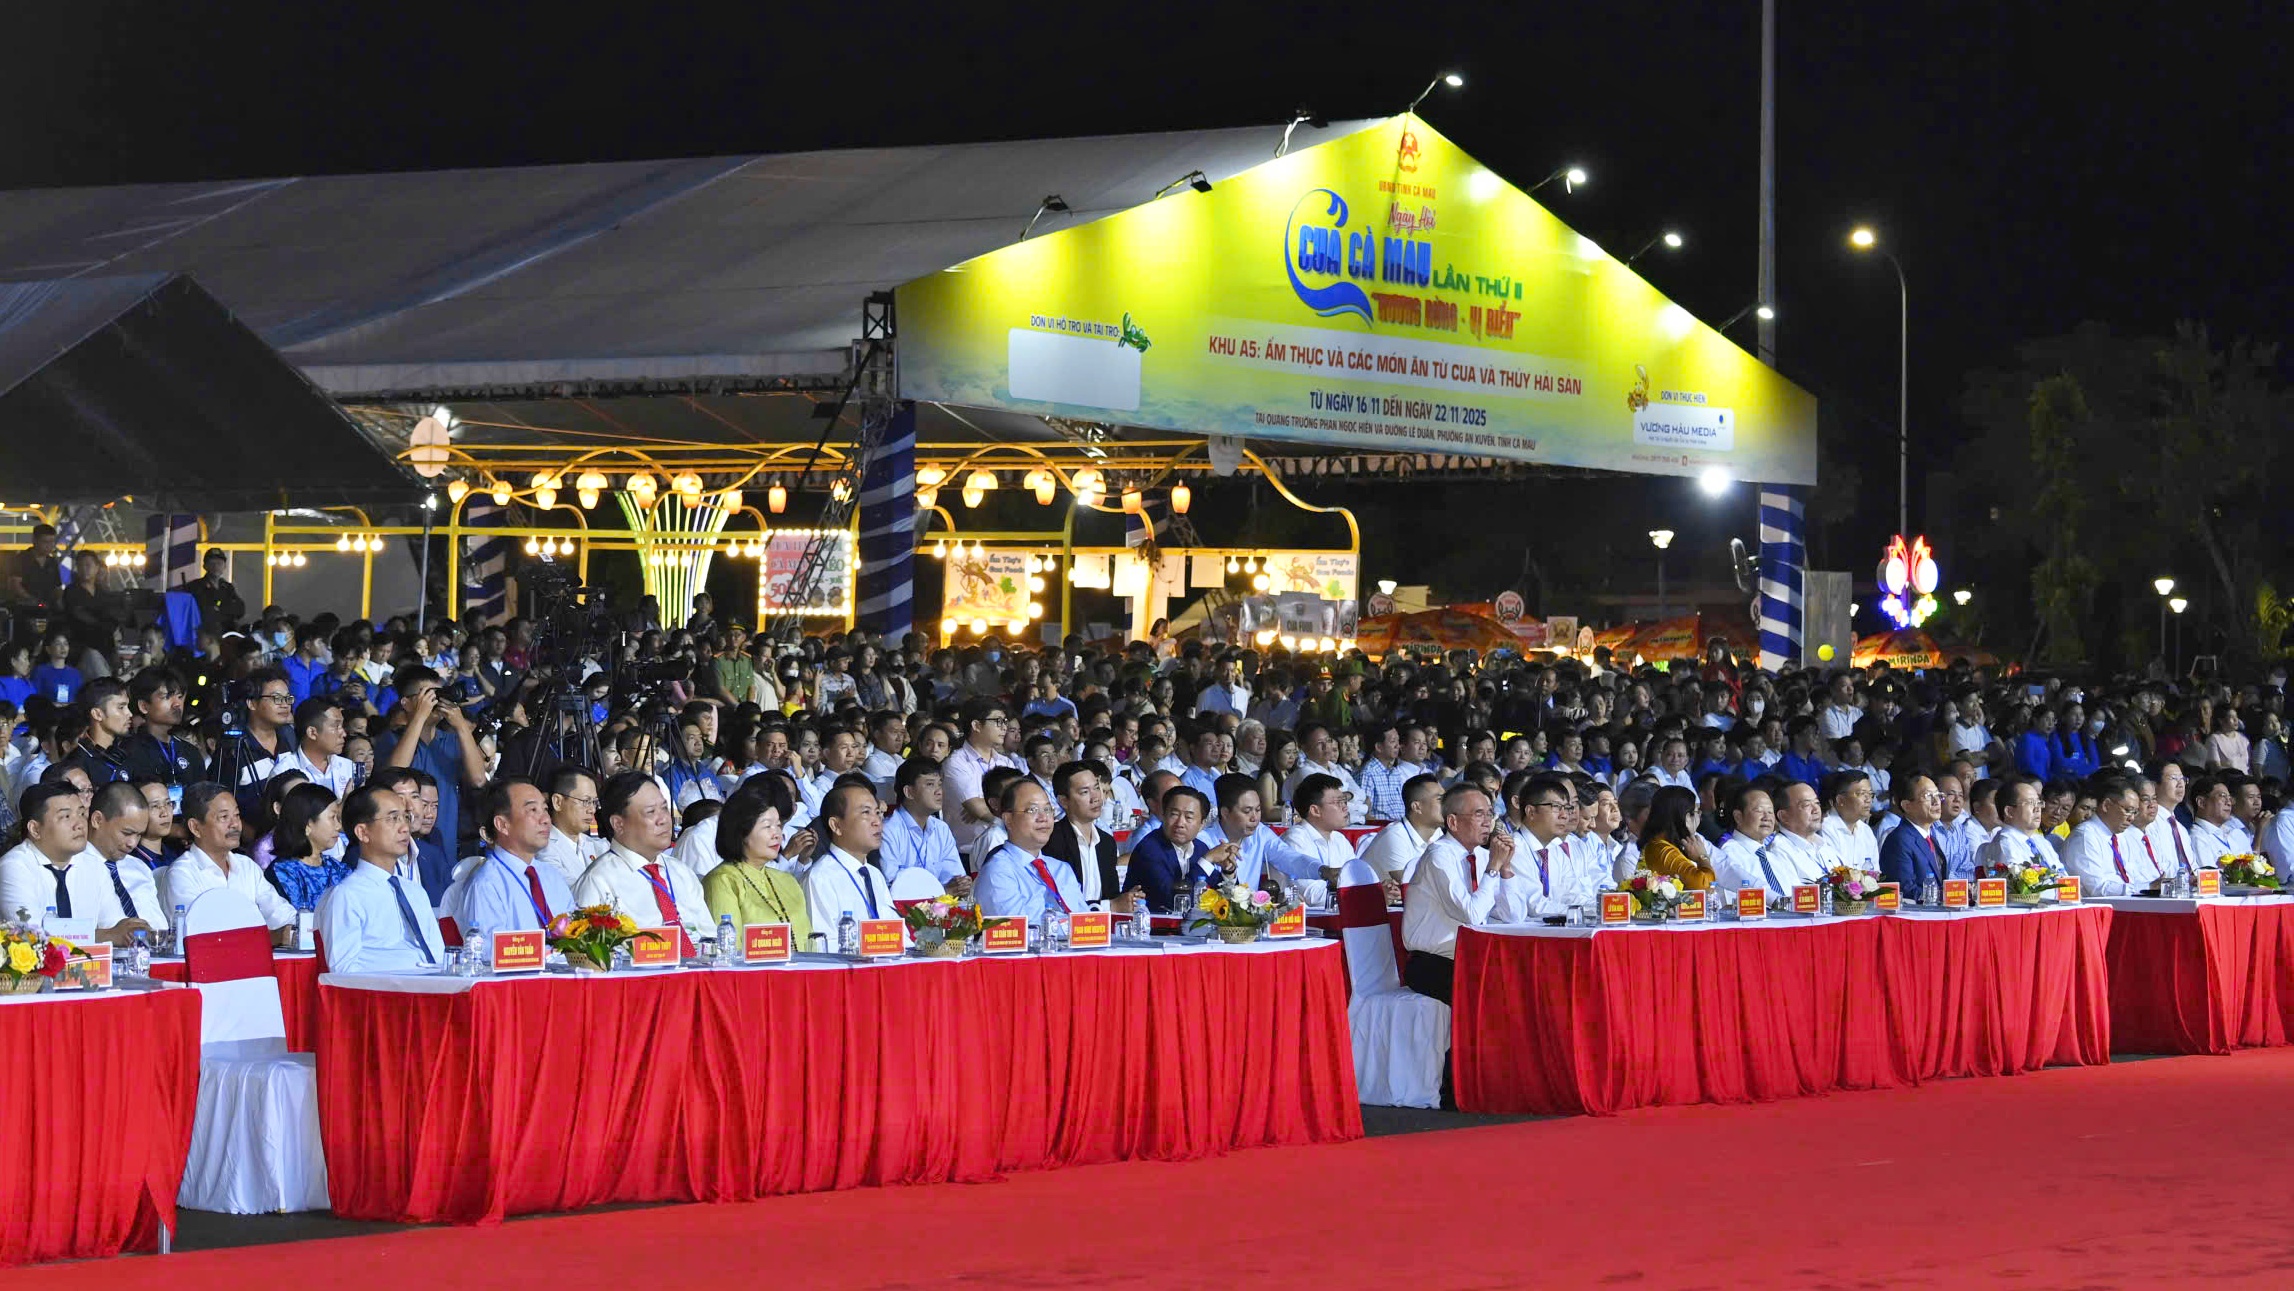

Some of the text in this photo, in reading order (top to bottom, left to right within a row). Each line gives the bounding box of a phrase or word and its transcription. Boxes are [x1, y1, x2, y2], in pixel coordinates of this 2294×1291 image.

[1298, 224, 1431, 288] CUA CÀ MAU
[1432, 263, 1470, 293] LẦN
[1475, 275, 1511, 298] THỨ
[1209, 335, 1236, 356] KHU
[1239, 339, 1261, 359] A5:
[1290, 345, 1323, 369] THỰC
[1327, 345, 1344, 368] VÀ
[1347, 348, 1373, 371] CÁC
[1377, 350, 1407, 375] MÓN
[1432, 358, 1448, 379] TỪ
[1451, 363, 1476, 383] CUA
[1480, 364, 1496, 385] VÀ
[1325, 390, 1354, 413] NGÀY
[1405, 398, 1433, 421] NGÀY
[1691, 427, 1717, 437] MEDIA
[1888, 653, 1930, 666] MIRINDA
